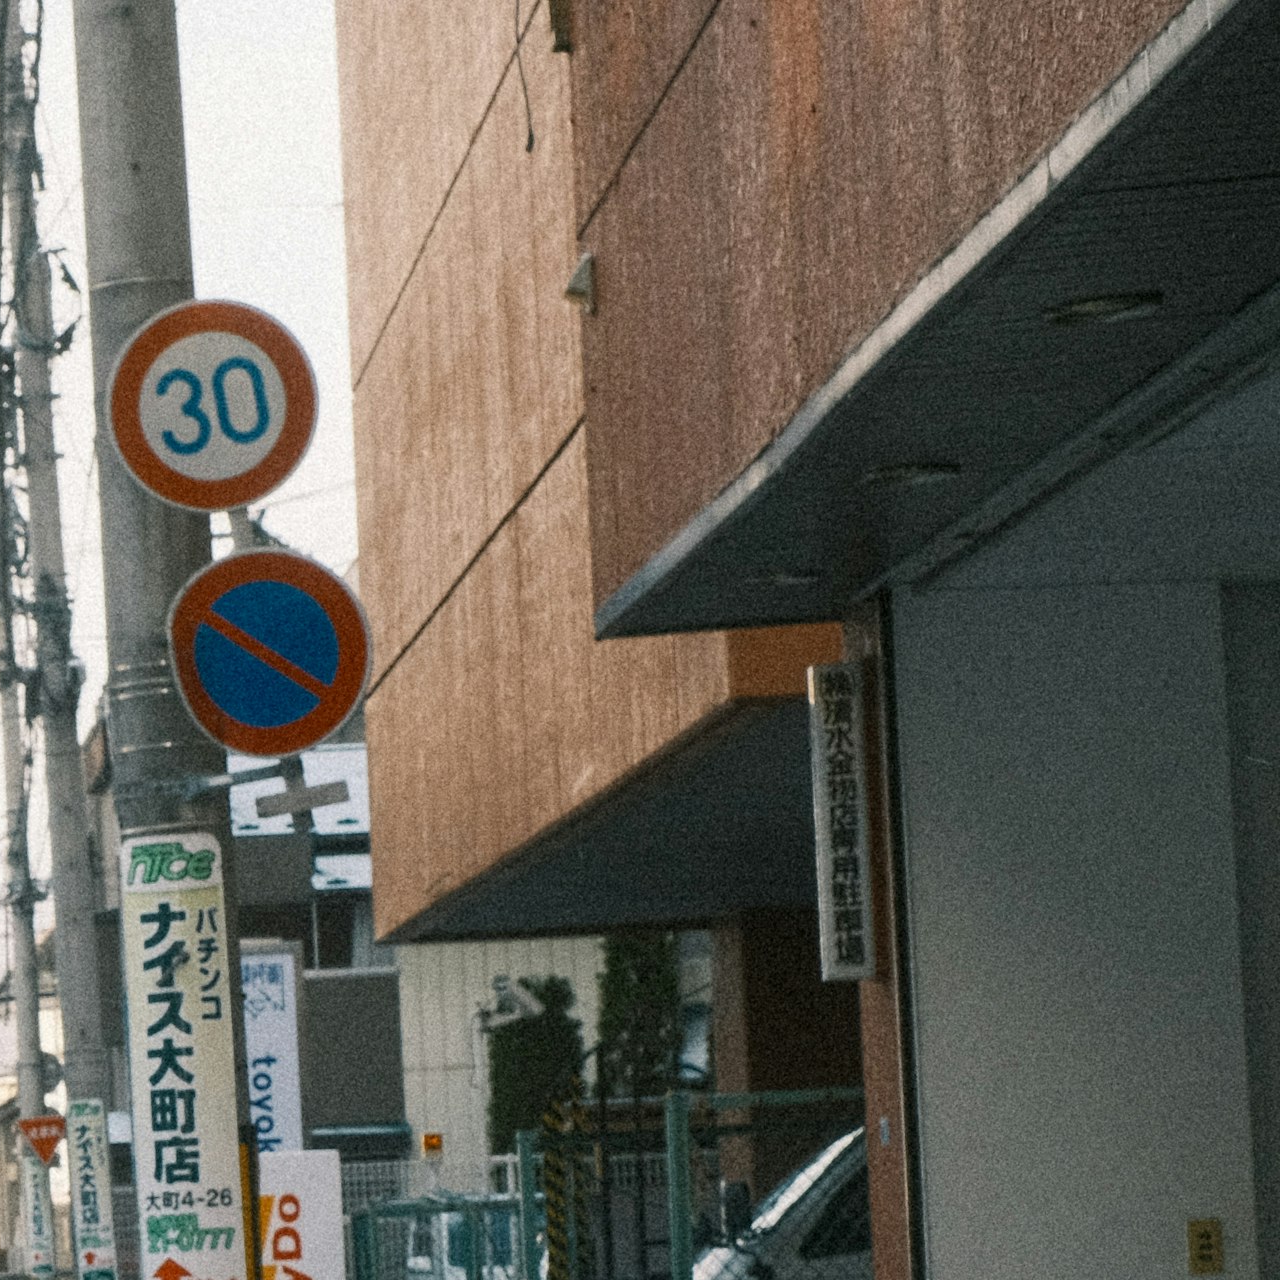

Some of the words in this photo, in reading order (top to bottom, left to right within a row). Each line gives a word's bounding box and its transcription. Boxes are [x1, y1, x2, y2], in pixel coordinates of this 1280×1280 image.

[157, 357, 270, 455] 30
[195, 906, 222, 1020] パチンコ
[139, 902, 200, 1184] ナイス大町店
[146, 1188, 233, 1211] 大町4-26
